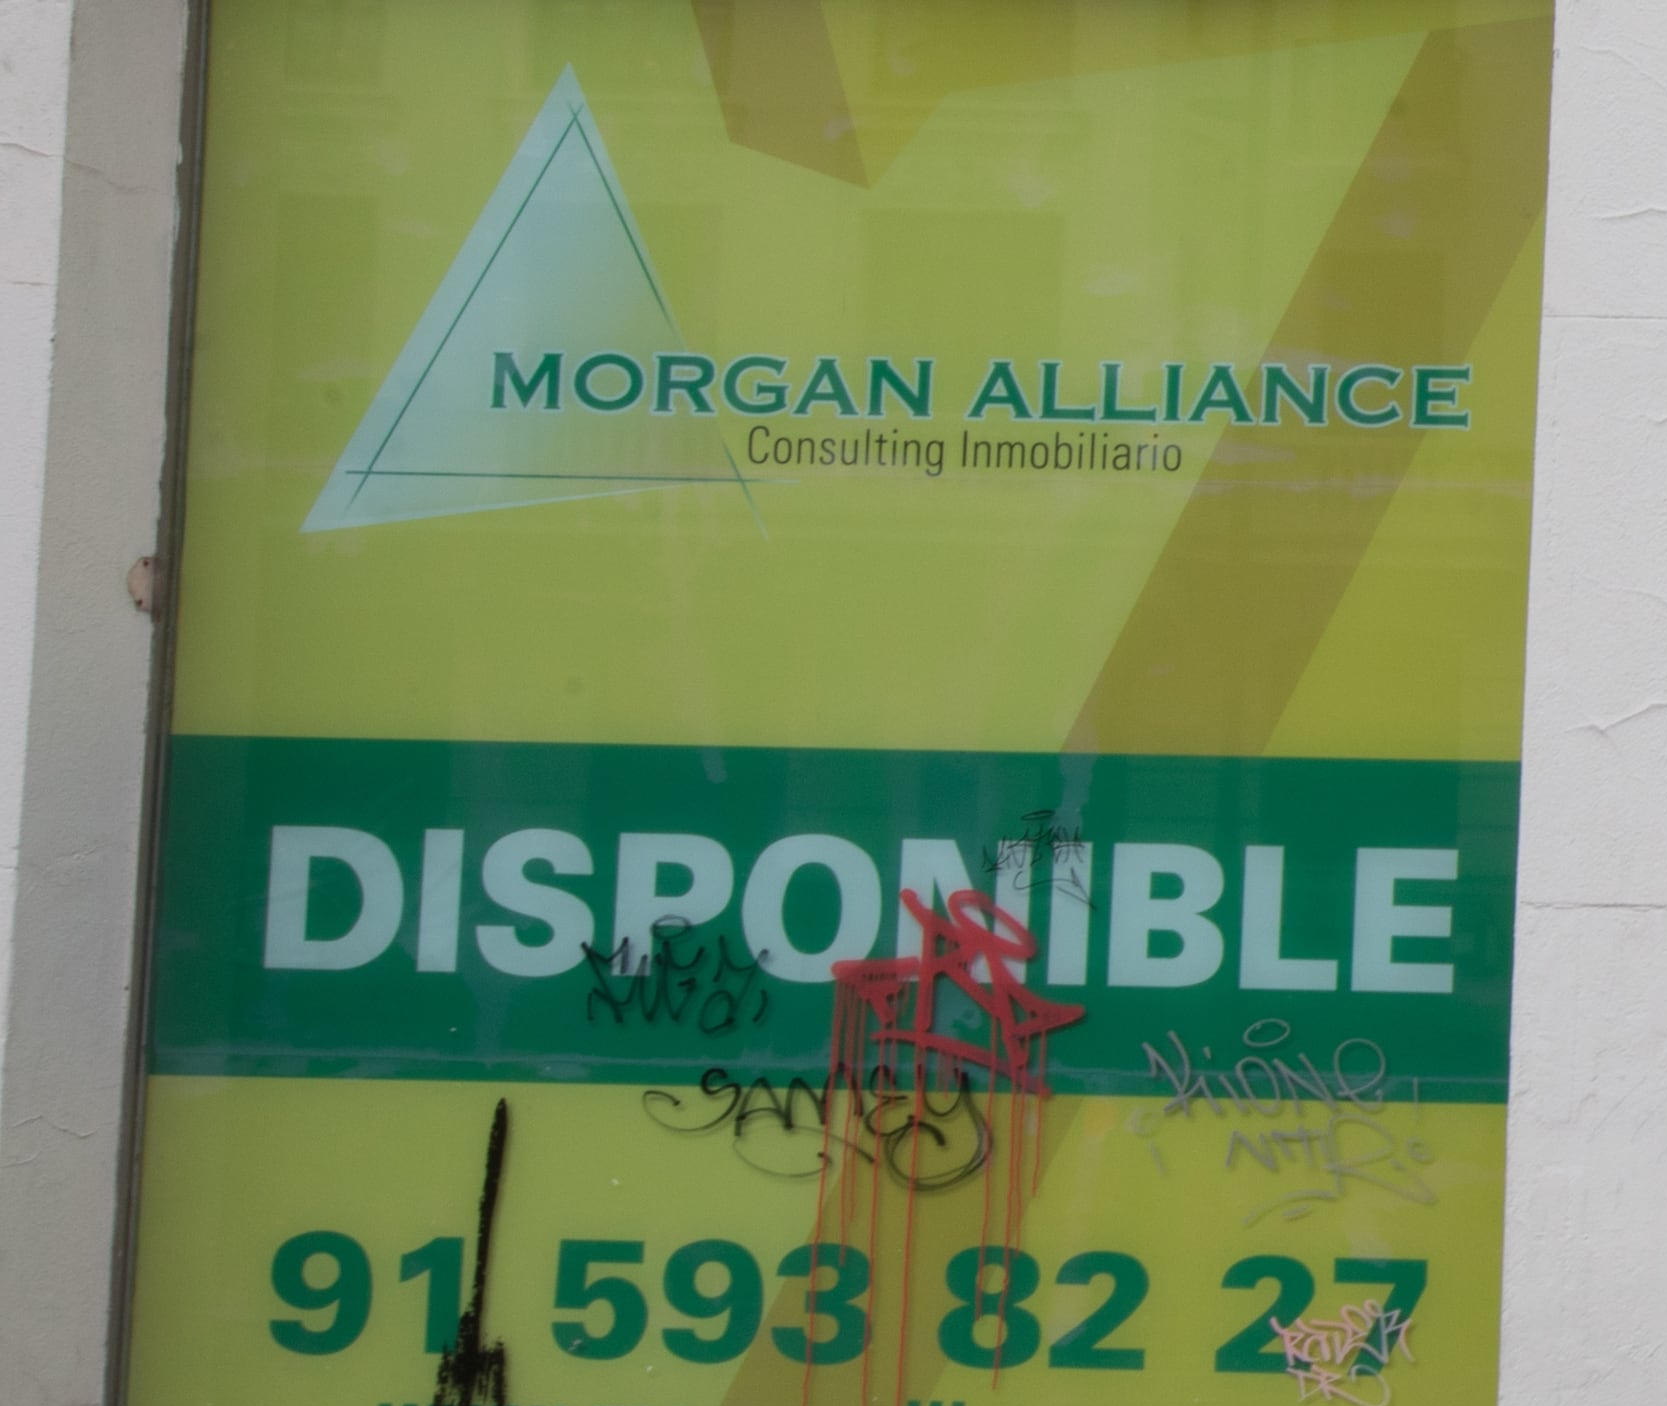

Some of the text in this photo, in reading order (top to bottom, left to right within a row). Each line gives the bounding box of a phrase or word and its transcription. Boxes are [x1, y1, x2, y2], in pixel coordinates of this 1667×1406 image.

[490, 350, 1474, 430] MORGAN ALLIANCE
[747, 425, 1183, 477] Consulting Inmobiliario
[262, 823, 1462, 995] DISPONIBLE
[268, 1230, 1429, 1377] 91 593 82 27
